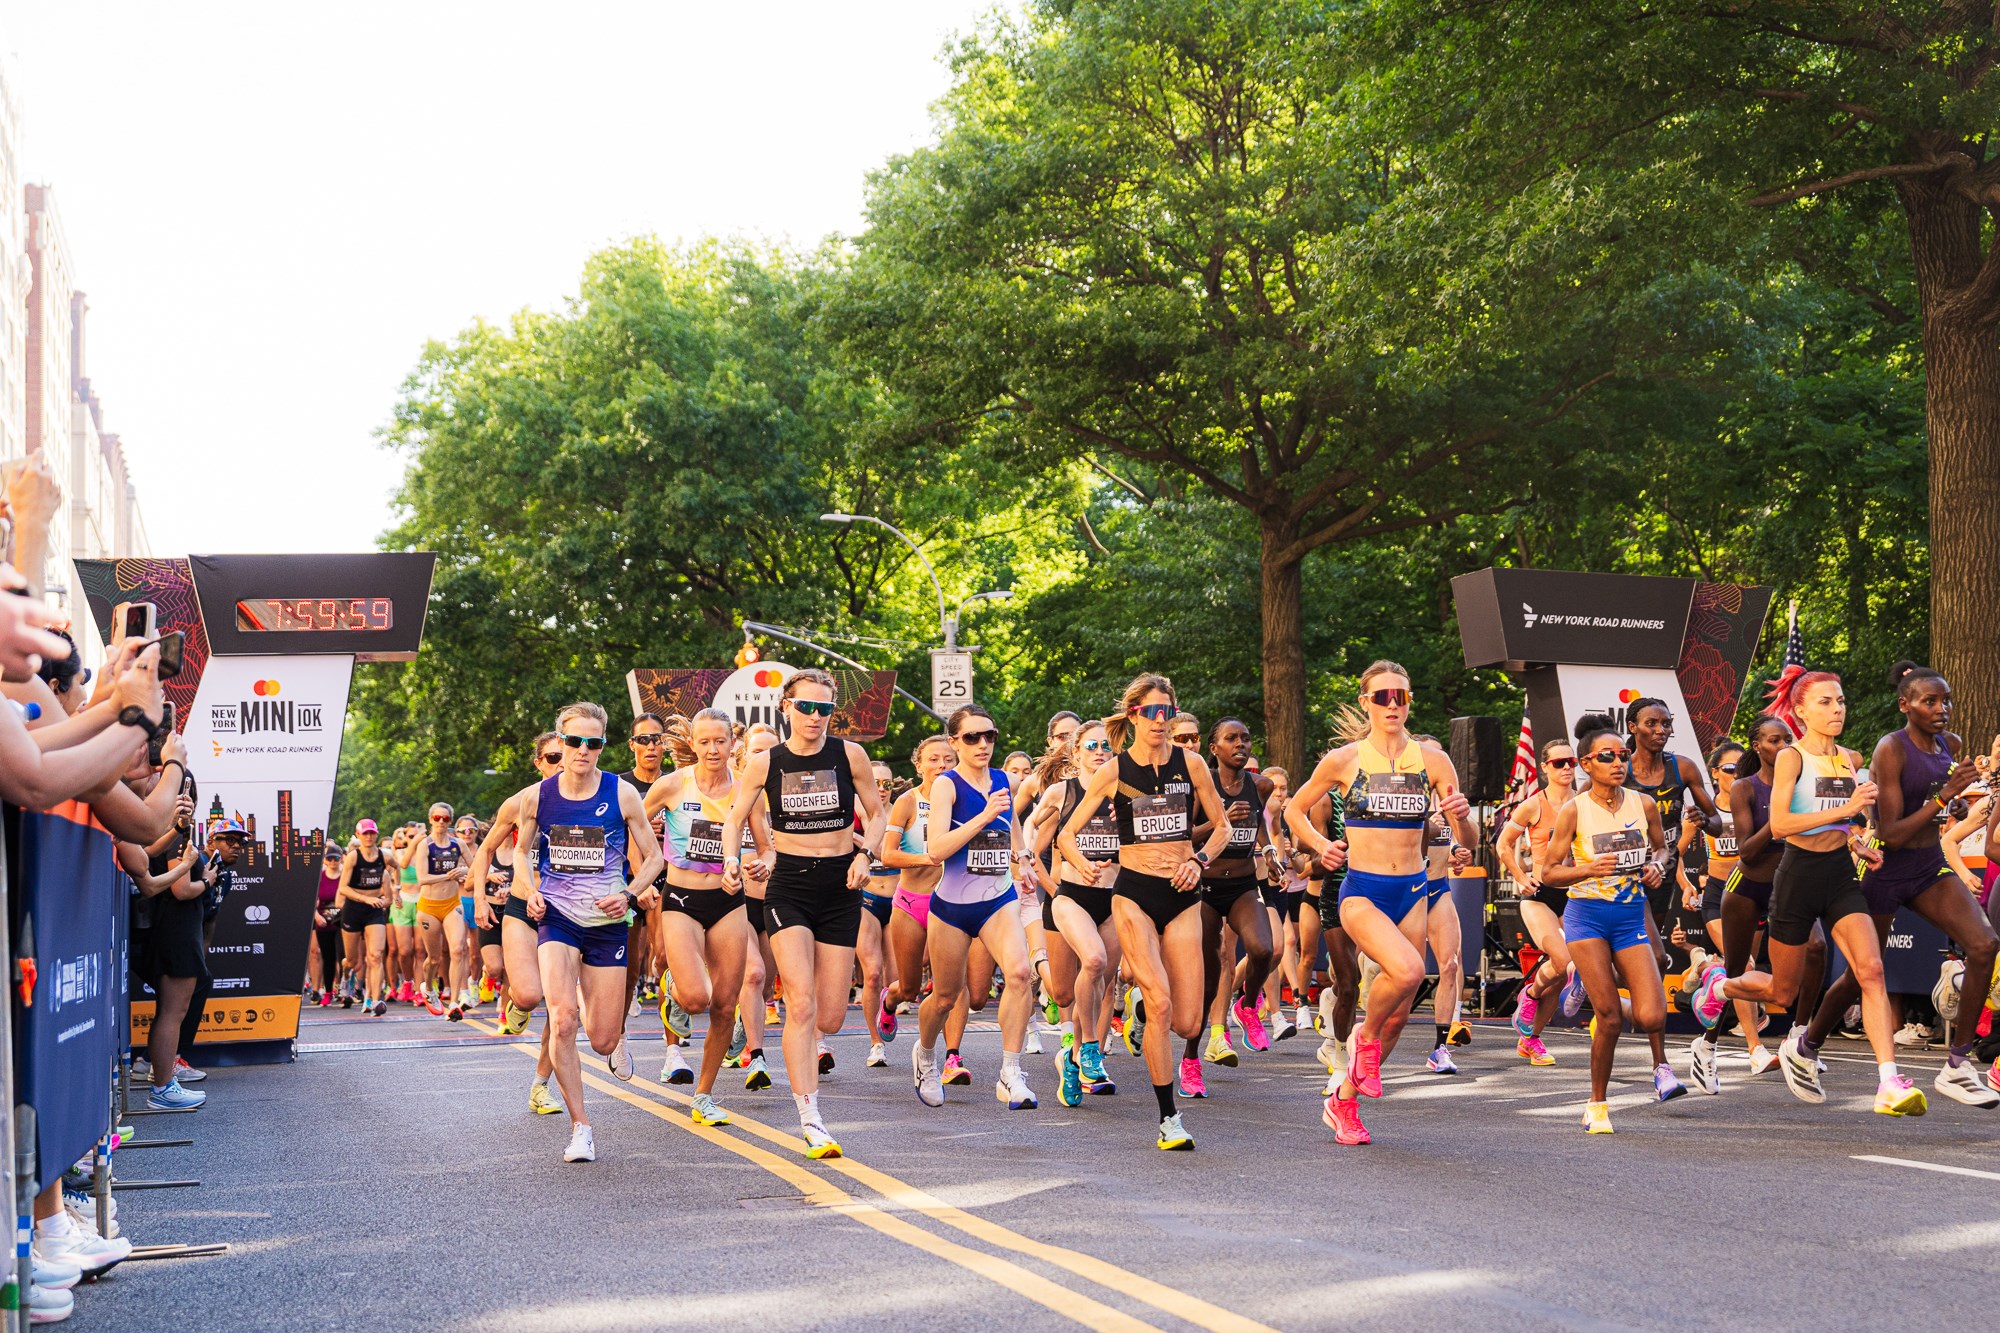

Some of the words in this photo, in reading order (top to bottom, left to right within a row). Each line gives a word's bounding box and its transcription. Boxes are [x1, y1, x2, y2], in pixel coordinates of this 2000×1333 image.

[1540, 614, 1564, 624] NEW
[1565, 616, 1591, 626] YORK
[1592, 617, 1619, 627] ROAD
[1620, 618, 1664, 629] RUNNERS
[940, 680, 966, 696] 25
[212, 709, 236, 718] NEW
[240, 701, 294, 735] MINI
[212, 720, 236, 728] YORK
[736, 706, 792, 740] MIN
[784, 794, 837, 808] RODENFELS
[1370, 796, 1423, 811] VENTERS
[785, 819, 844, 829] SALOMON
[1142, 816, 1180, 832] BRUCE
[551, 849, 603, 860] MCCORMACK
[972, 852, 1010, 865] HURLEY
[1886, 935, 1914, 948] NNERS
[213, 978, 250, 989] ESPN
